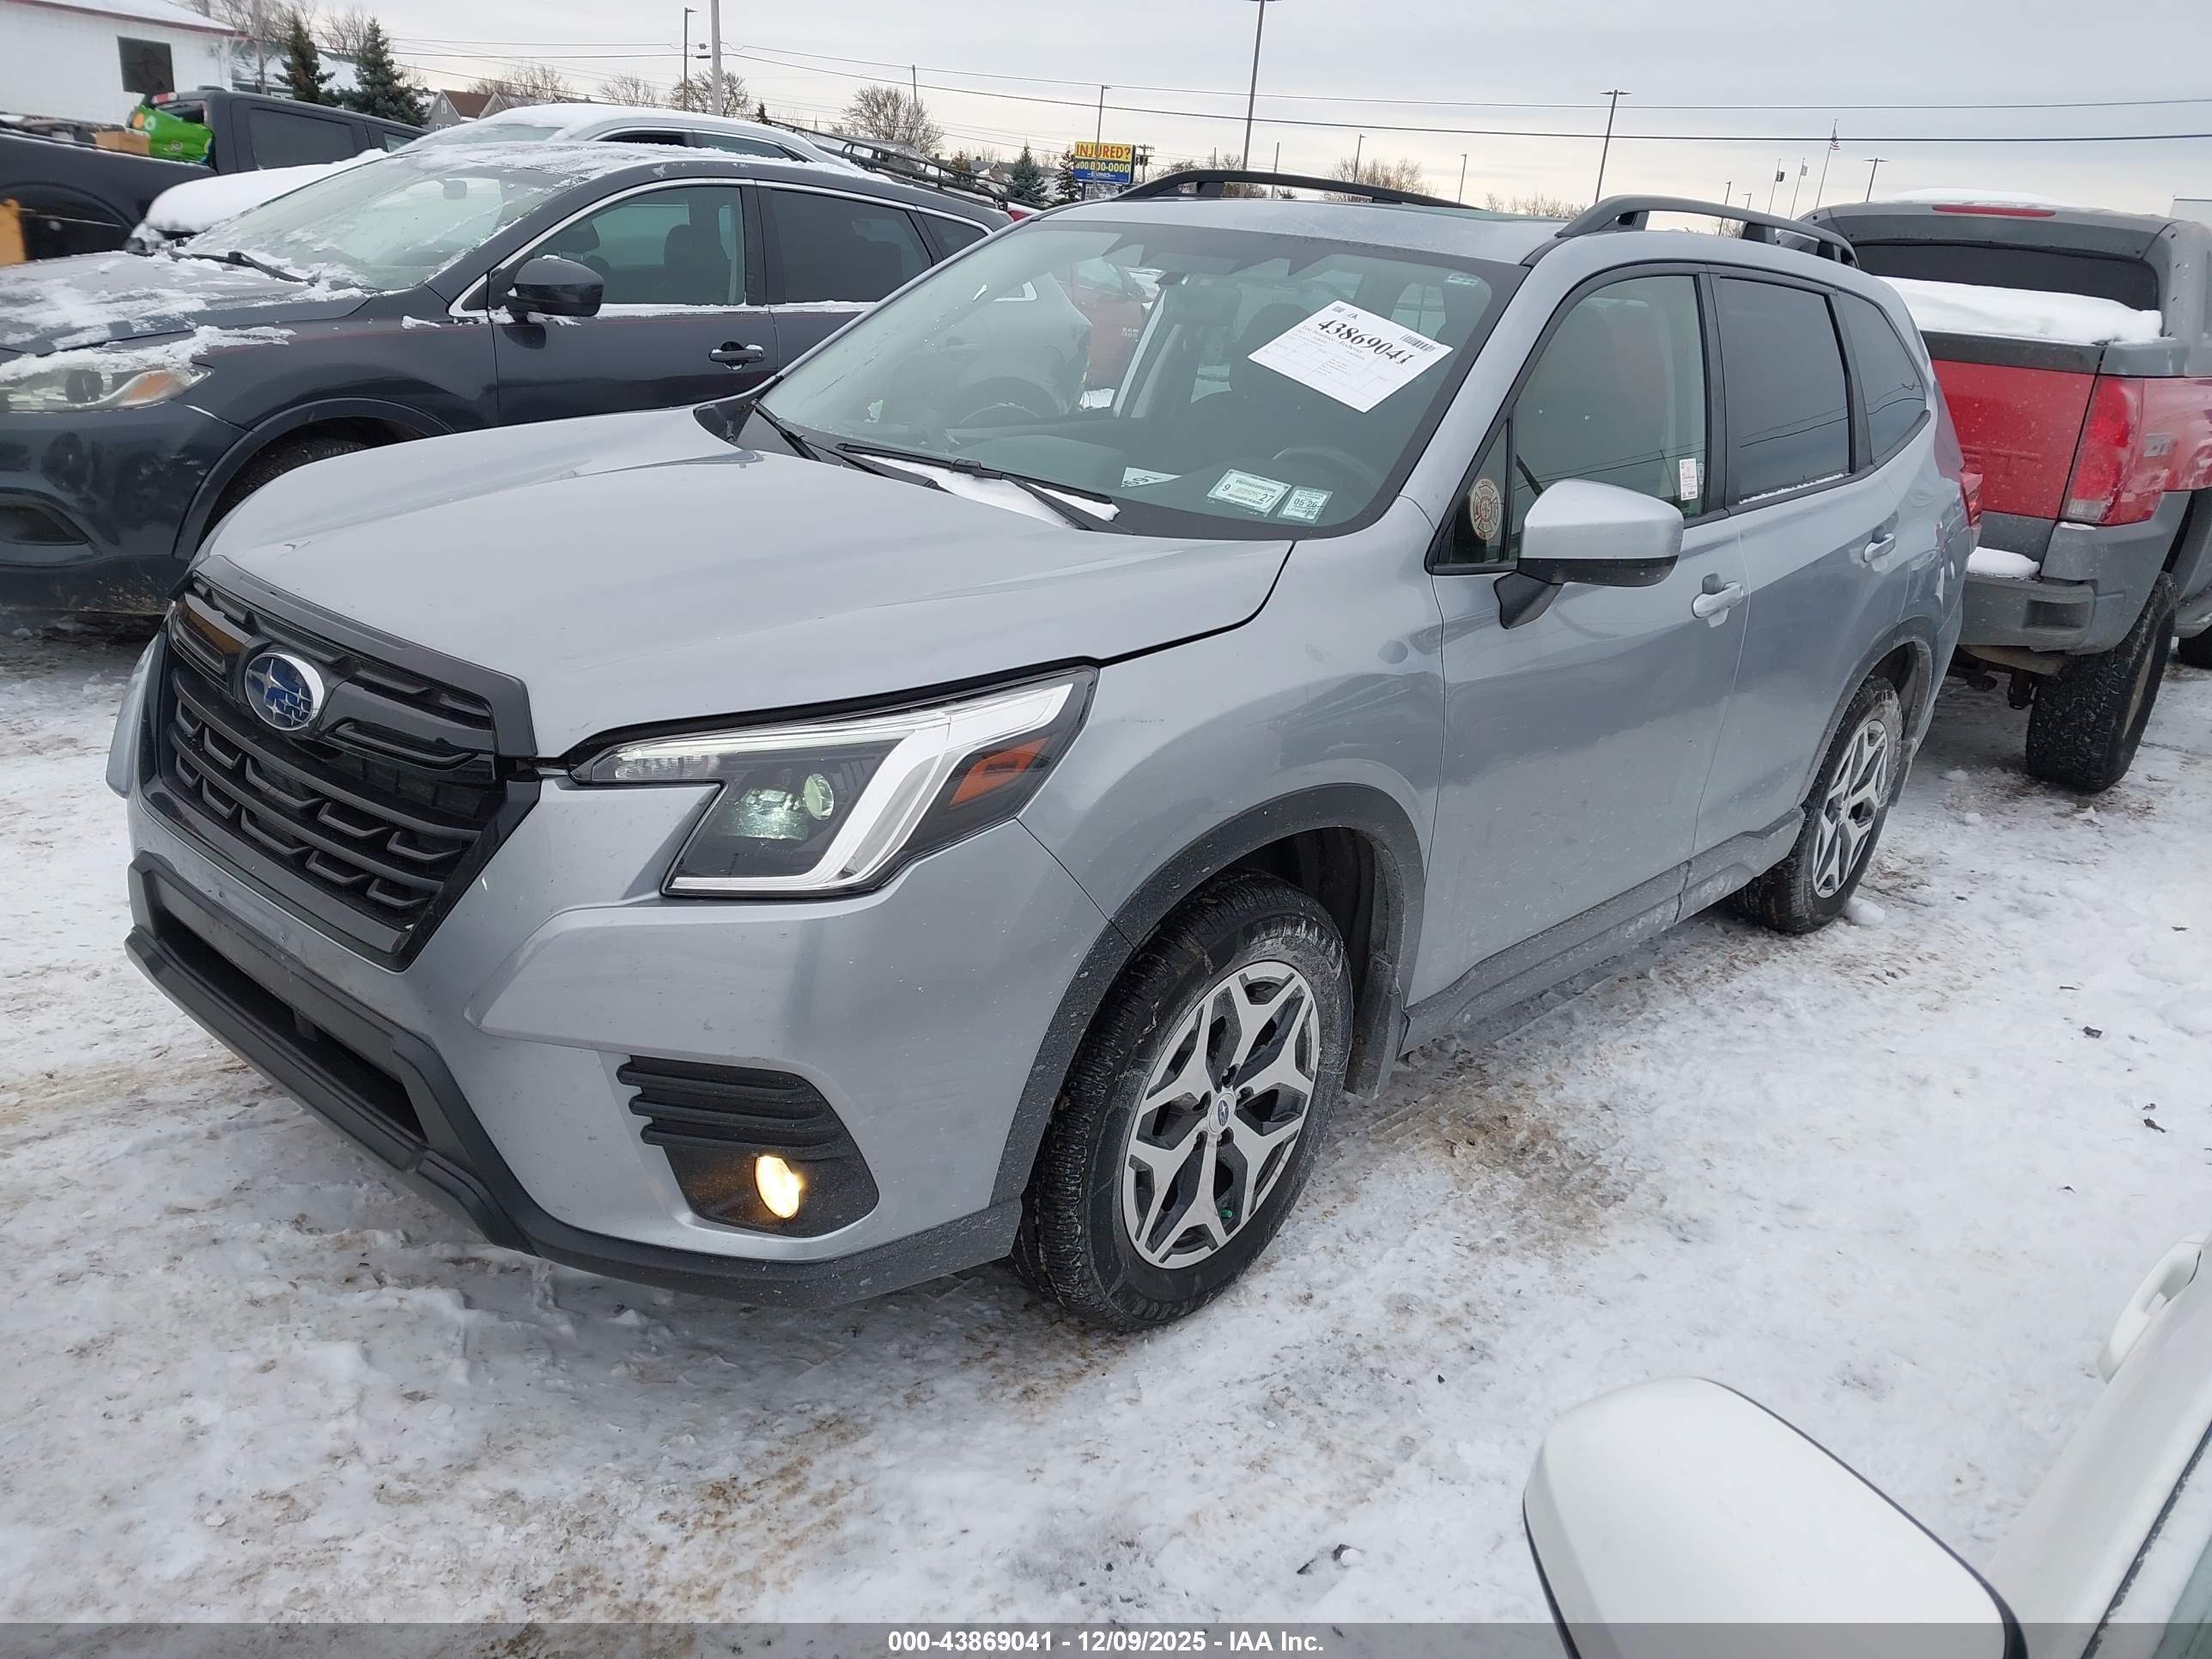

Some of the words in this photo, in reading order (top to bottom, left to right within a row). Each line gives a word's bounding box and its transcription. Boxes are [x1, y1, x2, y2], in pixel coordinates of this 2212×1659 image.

[1077, 143, 1131, 159] INJURED?
[1317, 319, 1415, 365] 43869041
[1222, 483, 1231, 492] 9
[1260, 494, 1275, 503] 27
